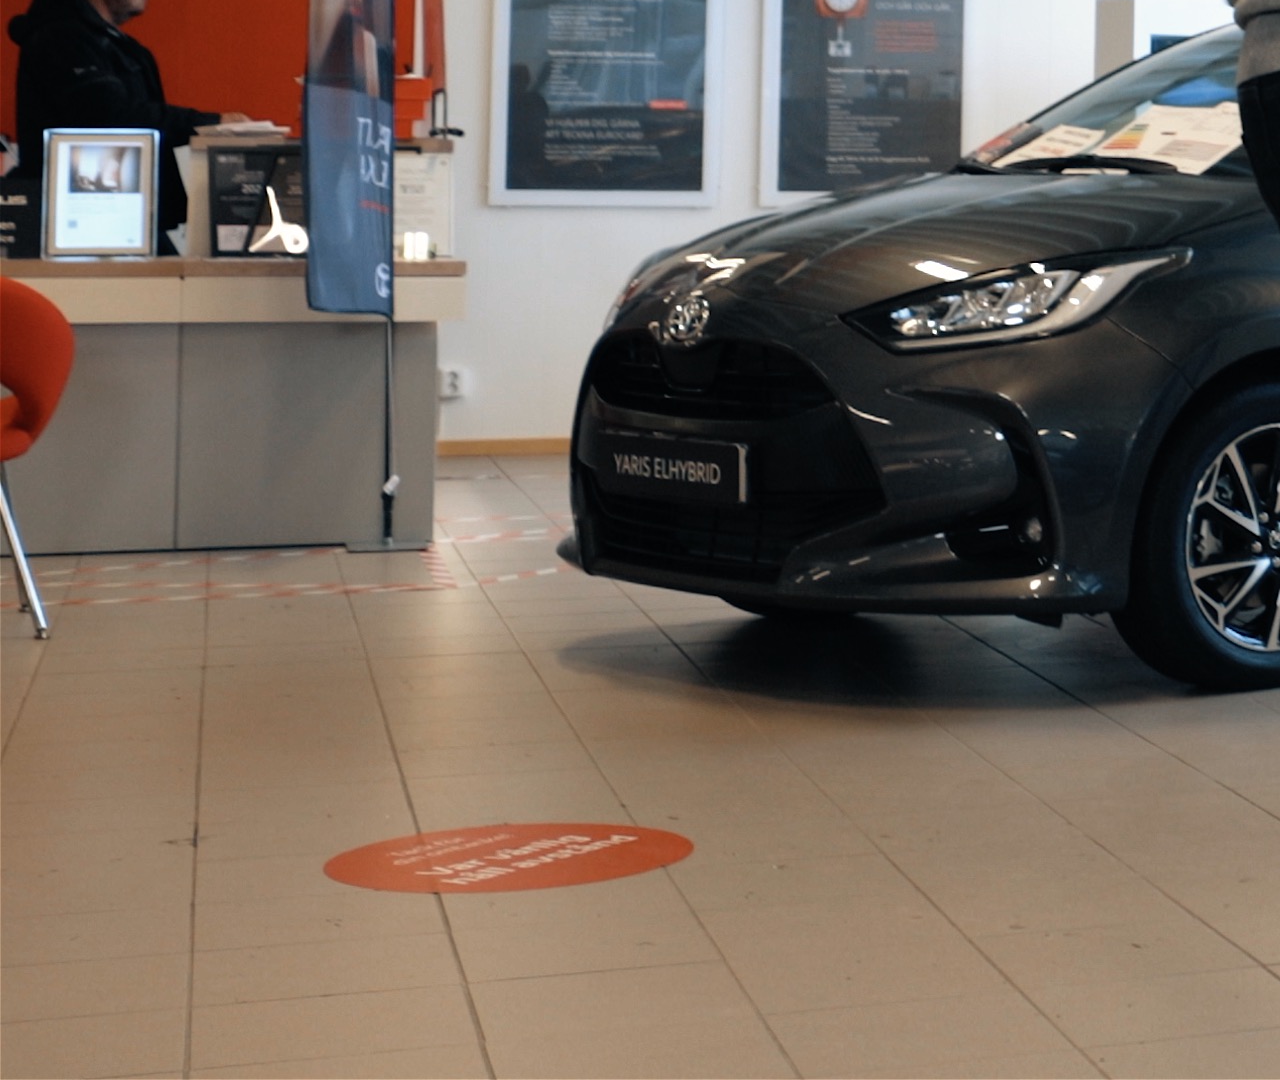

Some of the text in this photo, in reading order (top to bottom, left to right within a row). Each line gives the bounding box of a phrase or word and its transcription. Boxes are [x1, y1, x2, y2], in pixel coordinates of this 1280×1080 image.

[614, 452, 721, 484] YARIS ELHYBRID
[415, 834, 592, 875] Var vänlig
[441, 834, 639, 885] håll avstånd
